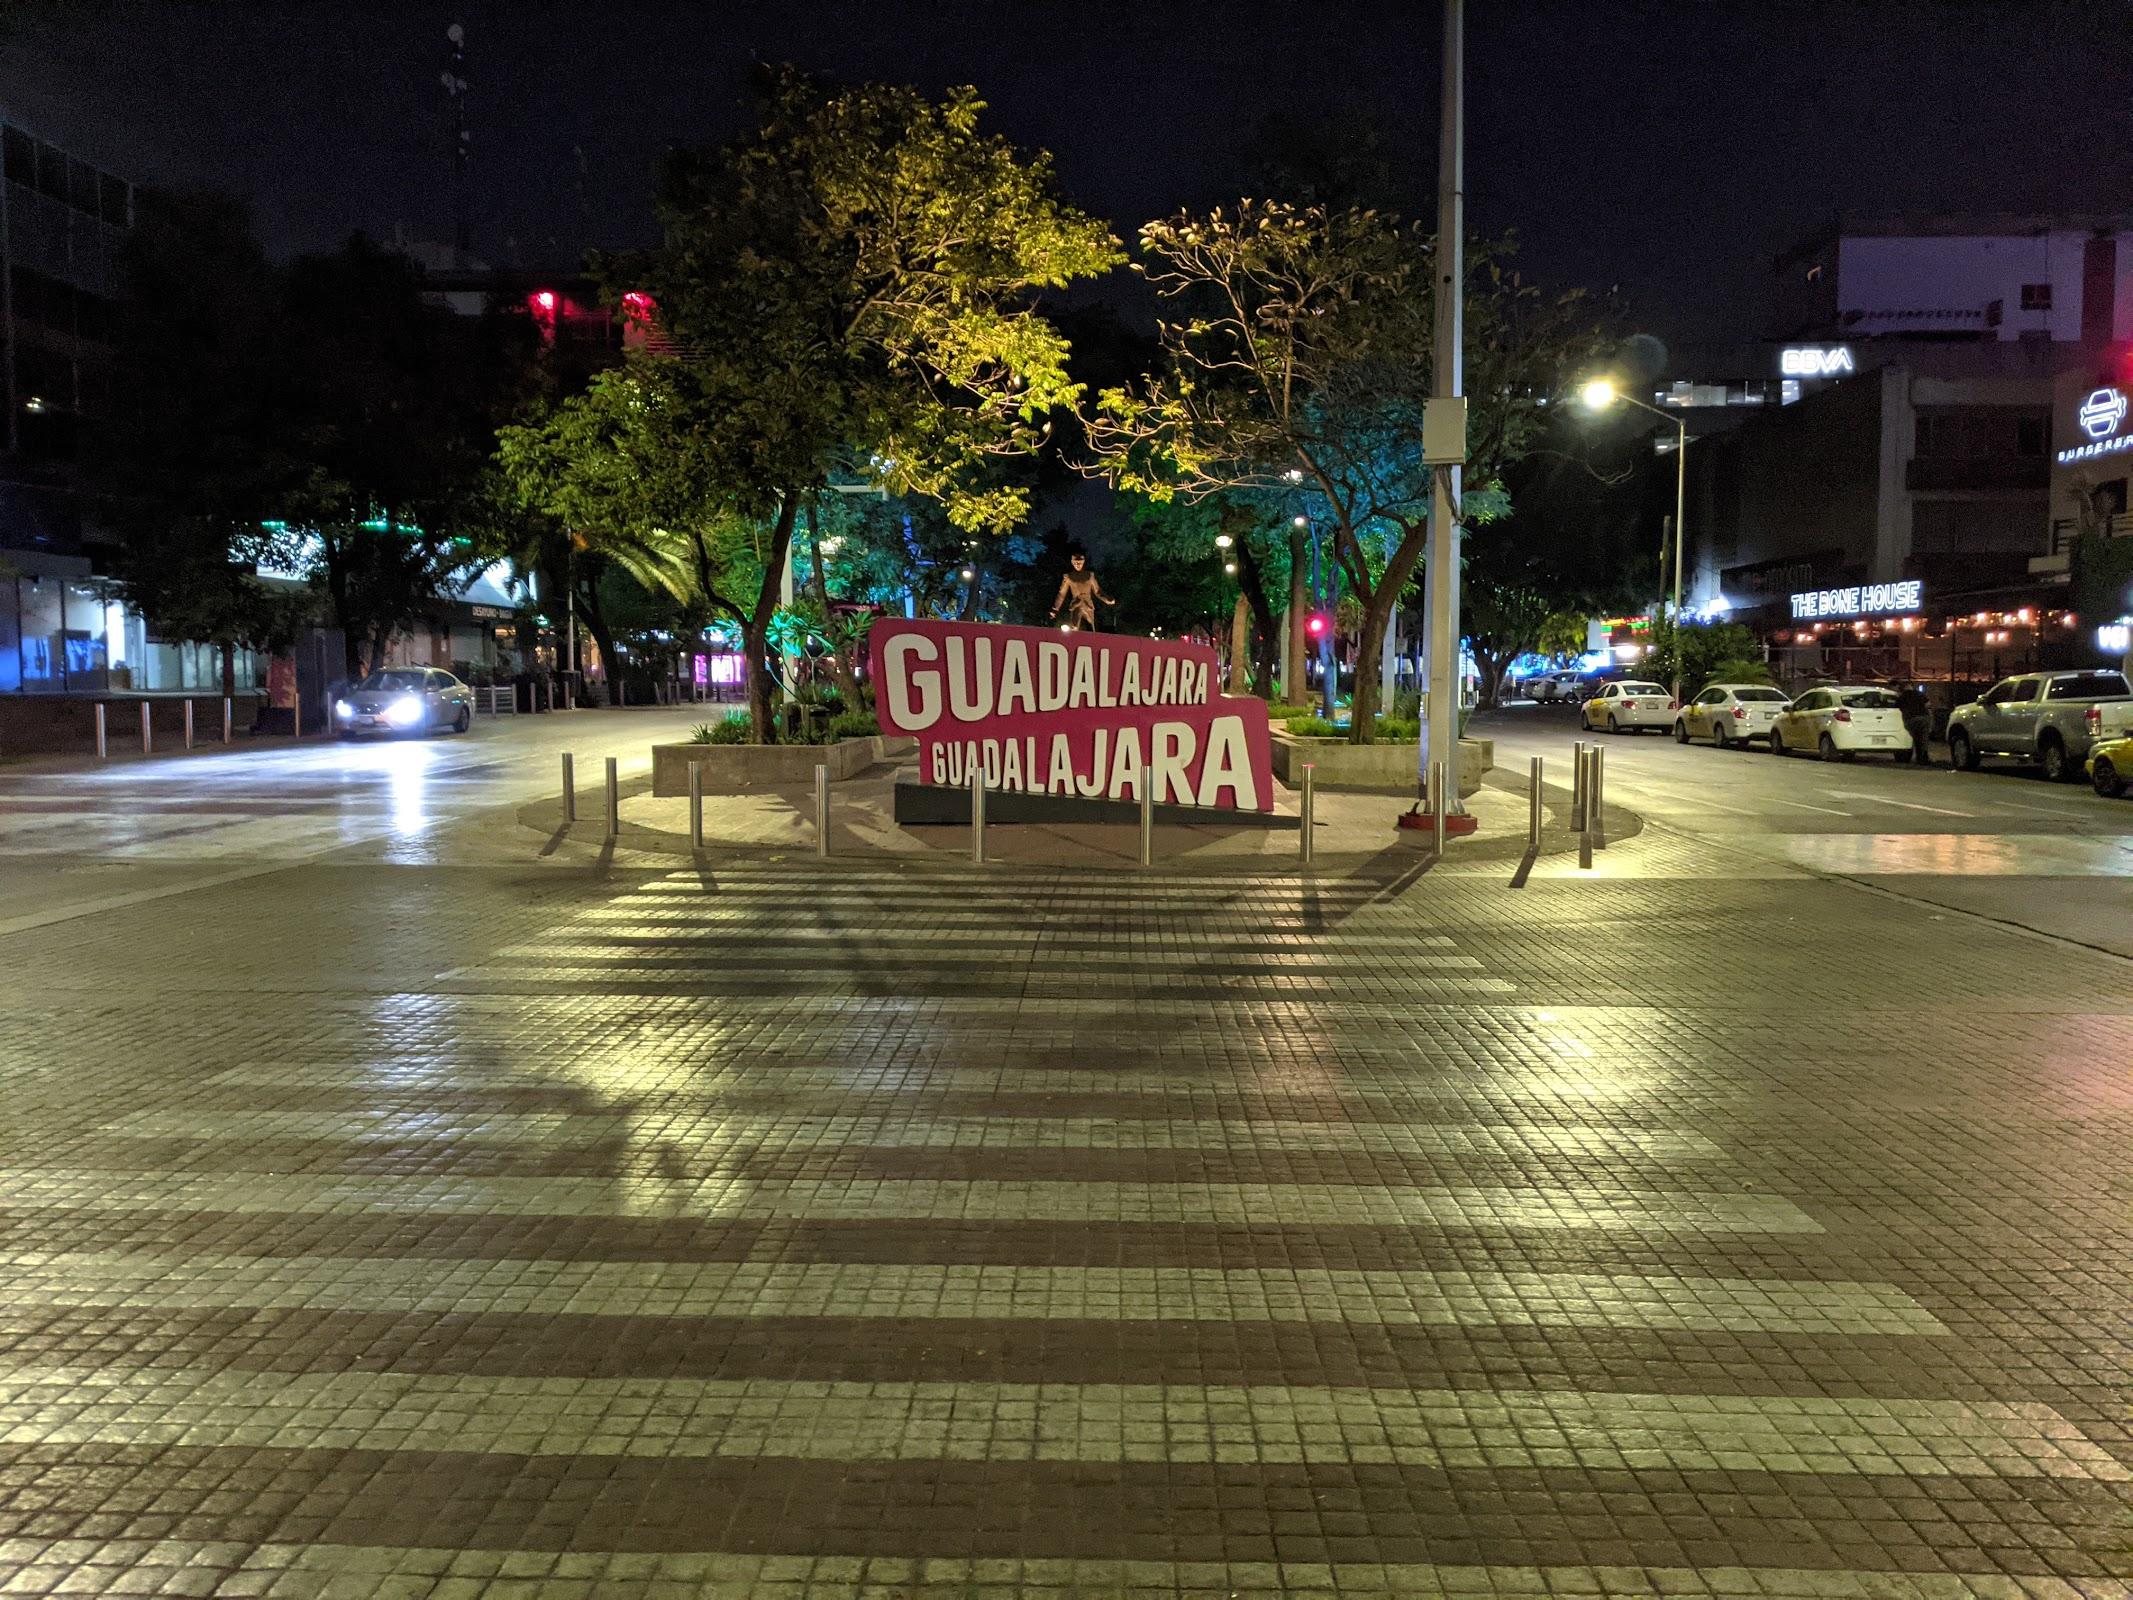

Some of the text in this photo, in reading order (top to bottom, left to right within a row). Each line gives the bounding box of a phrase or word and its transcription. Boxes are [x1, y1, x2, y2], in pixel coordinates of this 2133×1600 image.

[1782, 347, 1853, 374] BBVA
[1791, 581, 1920, 617] THE BONE HOUSE
[883, 633, 1208, 730] GUADALAJARA
[931, 716, 1257, 809] GUADALAJARA
